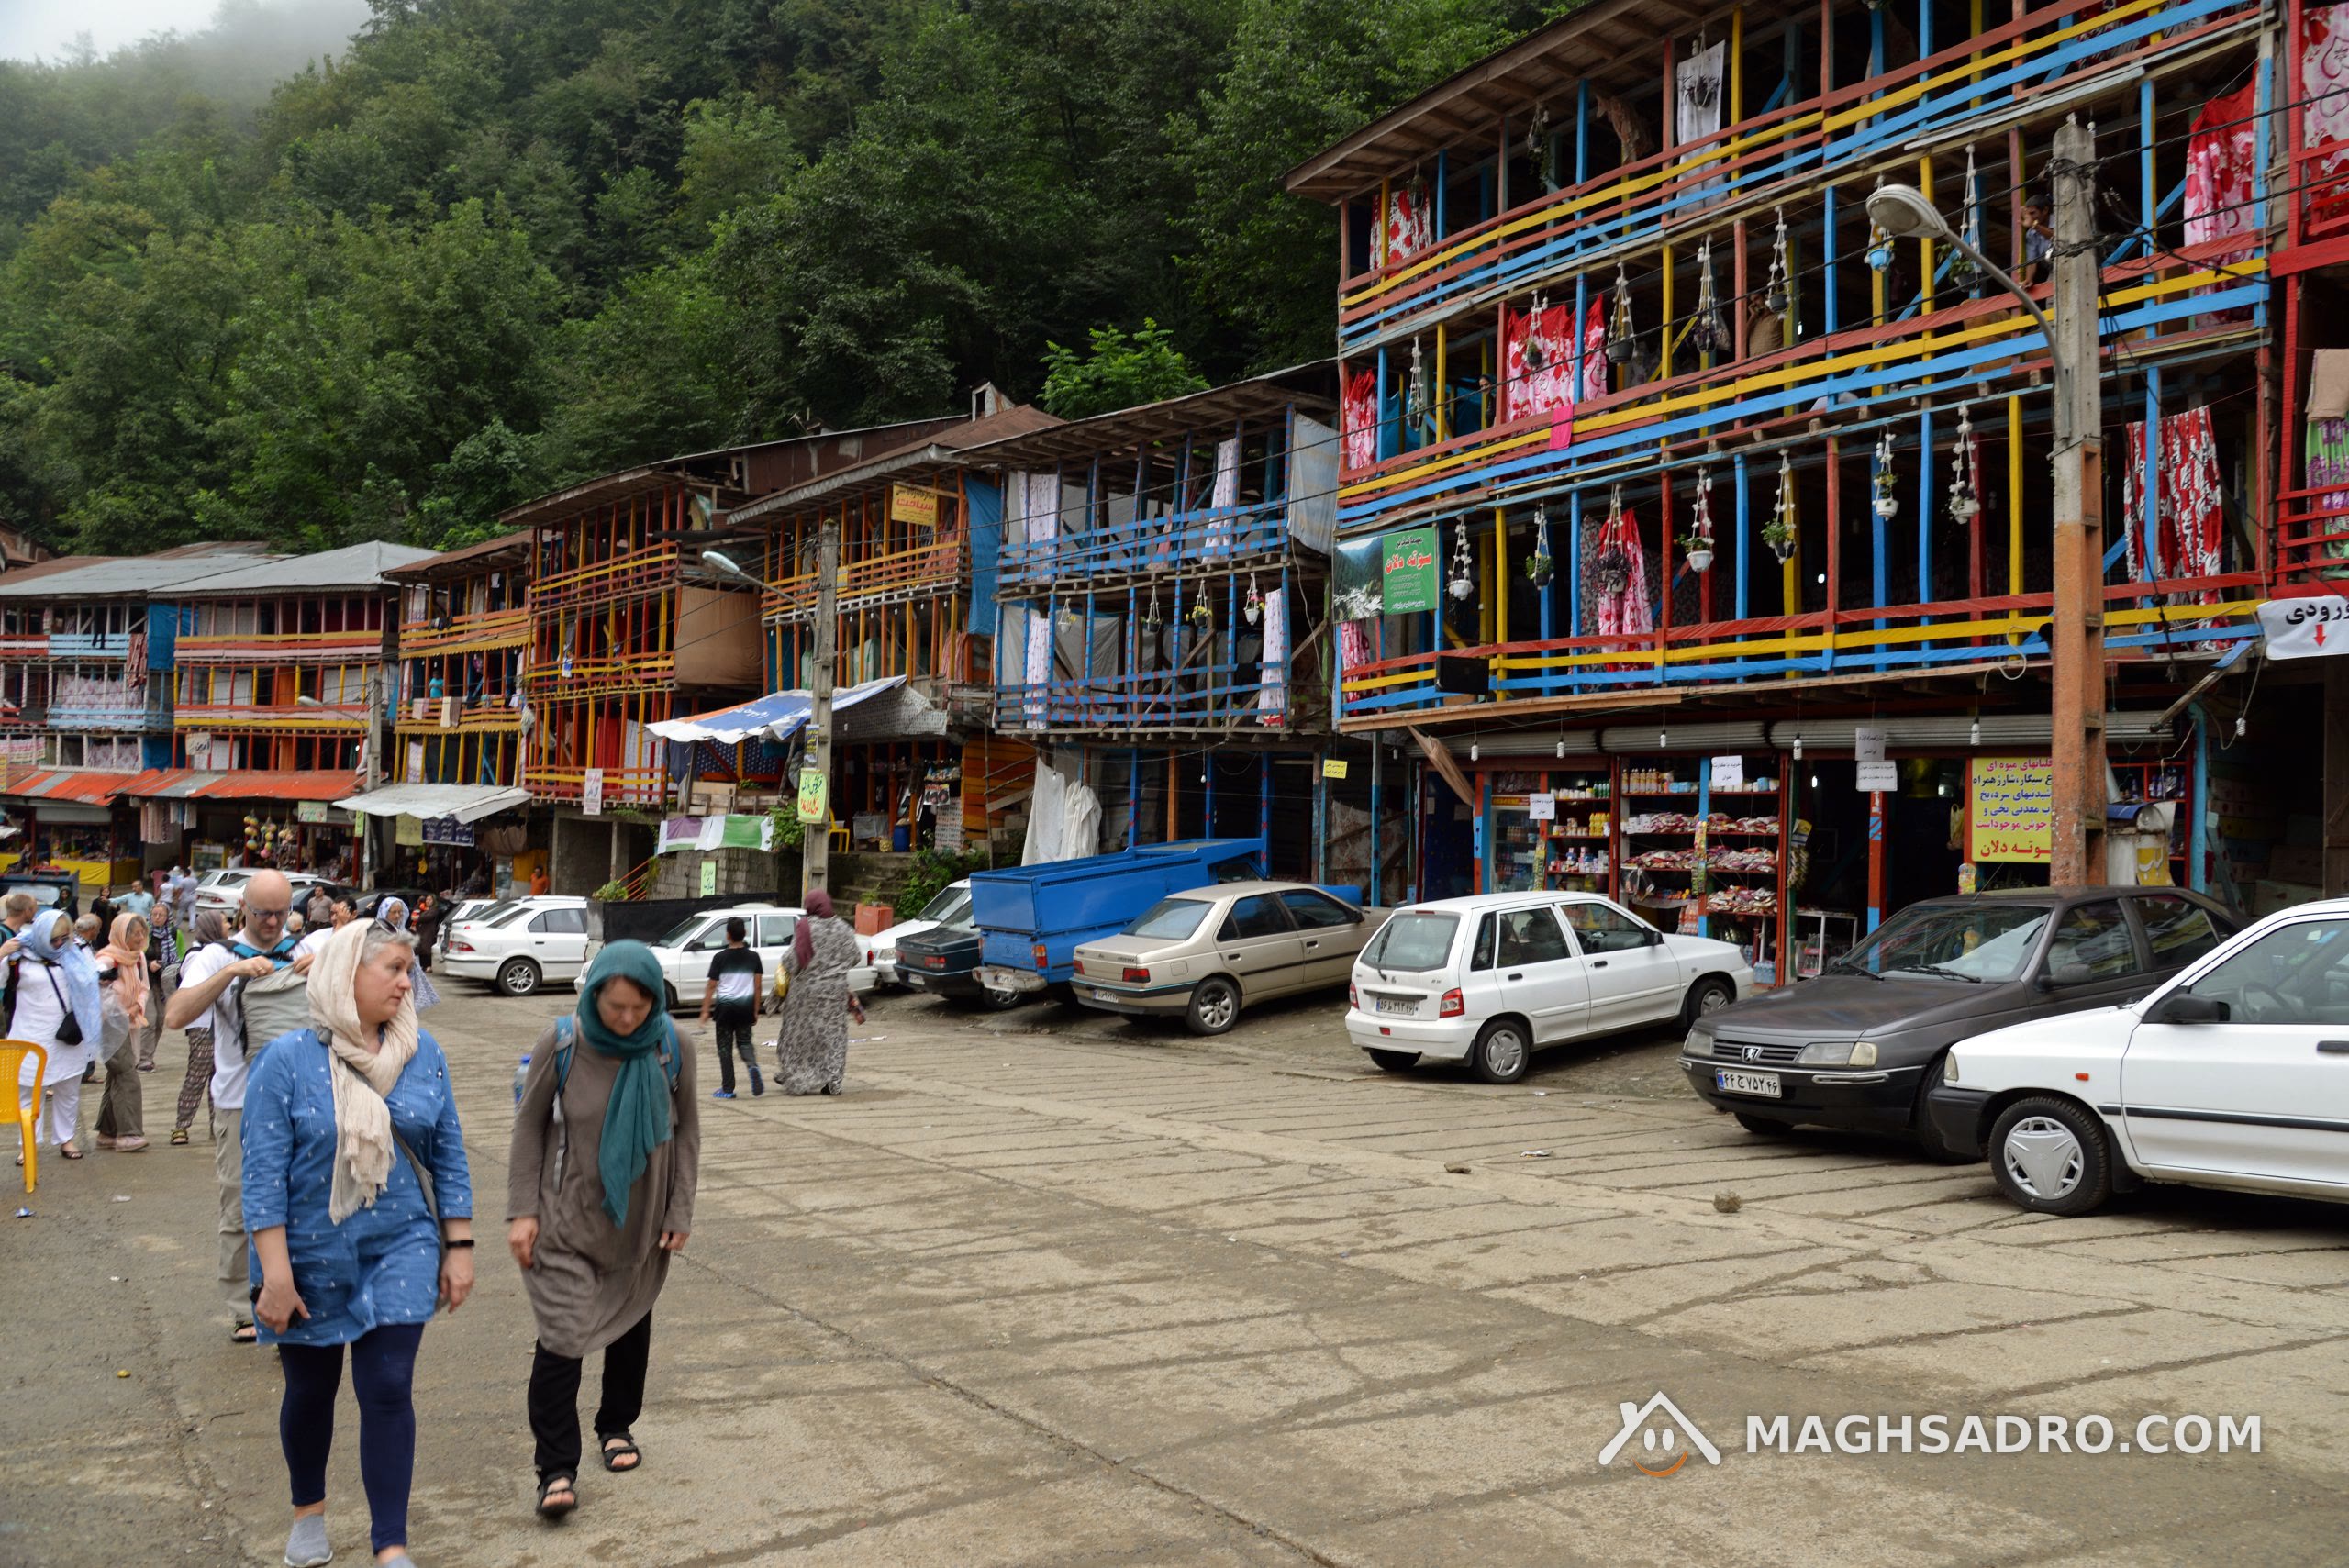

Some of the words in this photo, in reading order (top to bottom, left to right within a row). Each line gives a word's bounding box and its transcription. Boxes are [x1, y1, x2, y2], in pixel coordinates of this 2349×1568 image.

[1385, 553, 1405, 574] دلان
[1986, 760, 1998, 772] ای
[1999, 762, 2018, 772] میوه
[1983, 807, 1988, 816] و
[1990, 806, 2009, 816] یخی
[2011, 806, 2039, 816] معدنی
[1980, 840, 2008, 857] دلان
[1724, 1074, 1735, 1087] ۴۴
[1737, 1075, 1745, 1088] ج
[1746, 1076, 1765, 1091] ۷۵۲
[1766, 1081, 1777, 1093] ۴۶
